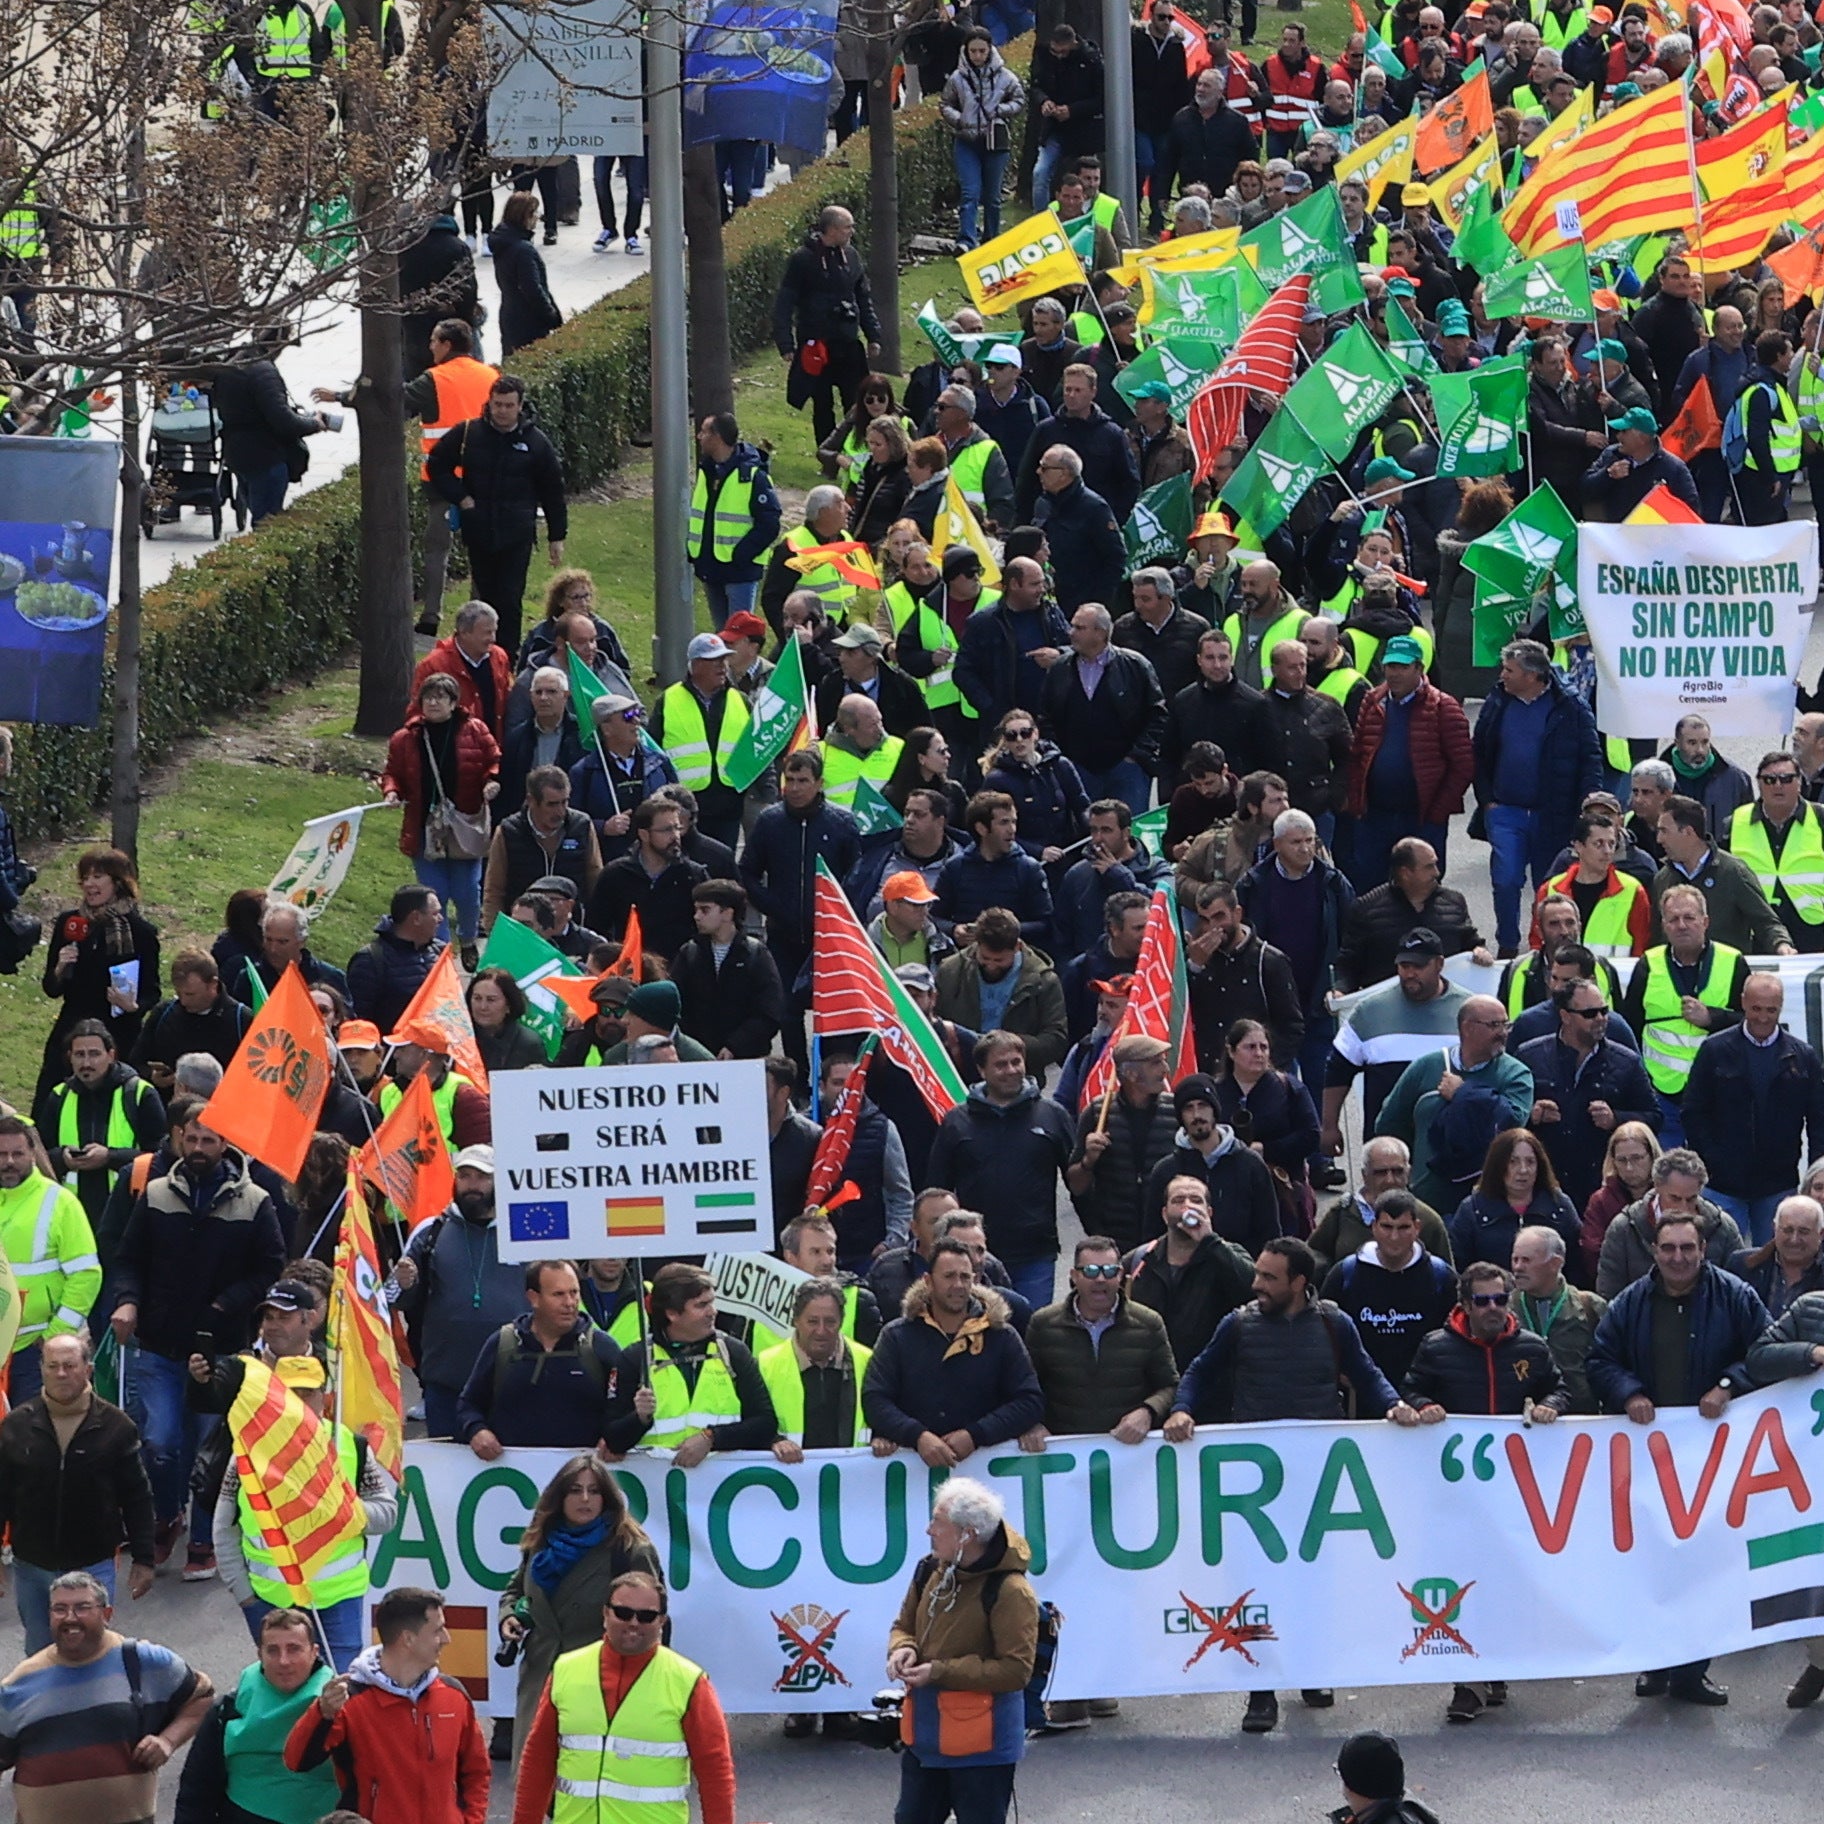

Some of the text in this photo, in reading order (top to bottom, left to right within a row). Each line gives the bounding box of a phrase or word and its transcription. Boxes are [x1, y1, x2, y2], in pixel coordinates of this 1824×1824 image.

[545, 133, 605, 148] MADRID
[1442, 425, 1470, 473] TOLEDO
[1597, 560, 1804, 596] ESPAÑA DESPIERTA,
[1632, 600, 1774, 638] SIN CAMPO
[1619, 645, 1788, 678] NO HAY VIDA
[1683, 681, 1723, 693] AgroBio
[753, 704, 798, 759] ASAJA
[538, 1082, 720, 1111] NUESTRO FIN
[596, 1118, 668, 1149] SERÁ
[508, 1158, 759, 1192] VUESTRA HAMBRE
[1361, 1307, 1423, 1328] Pepe Jeans
[779, 1663, 838, 1694] UPA
